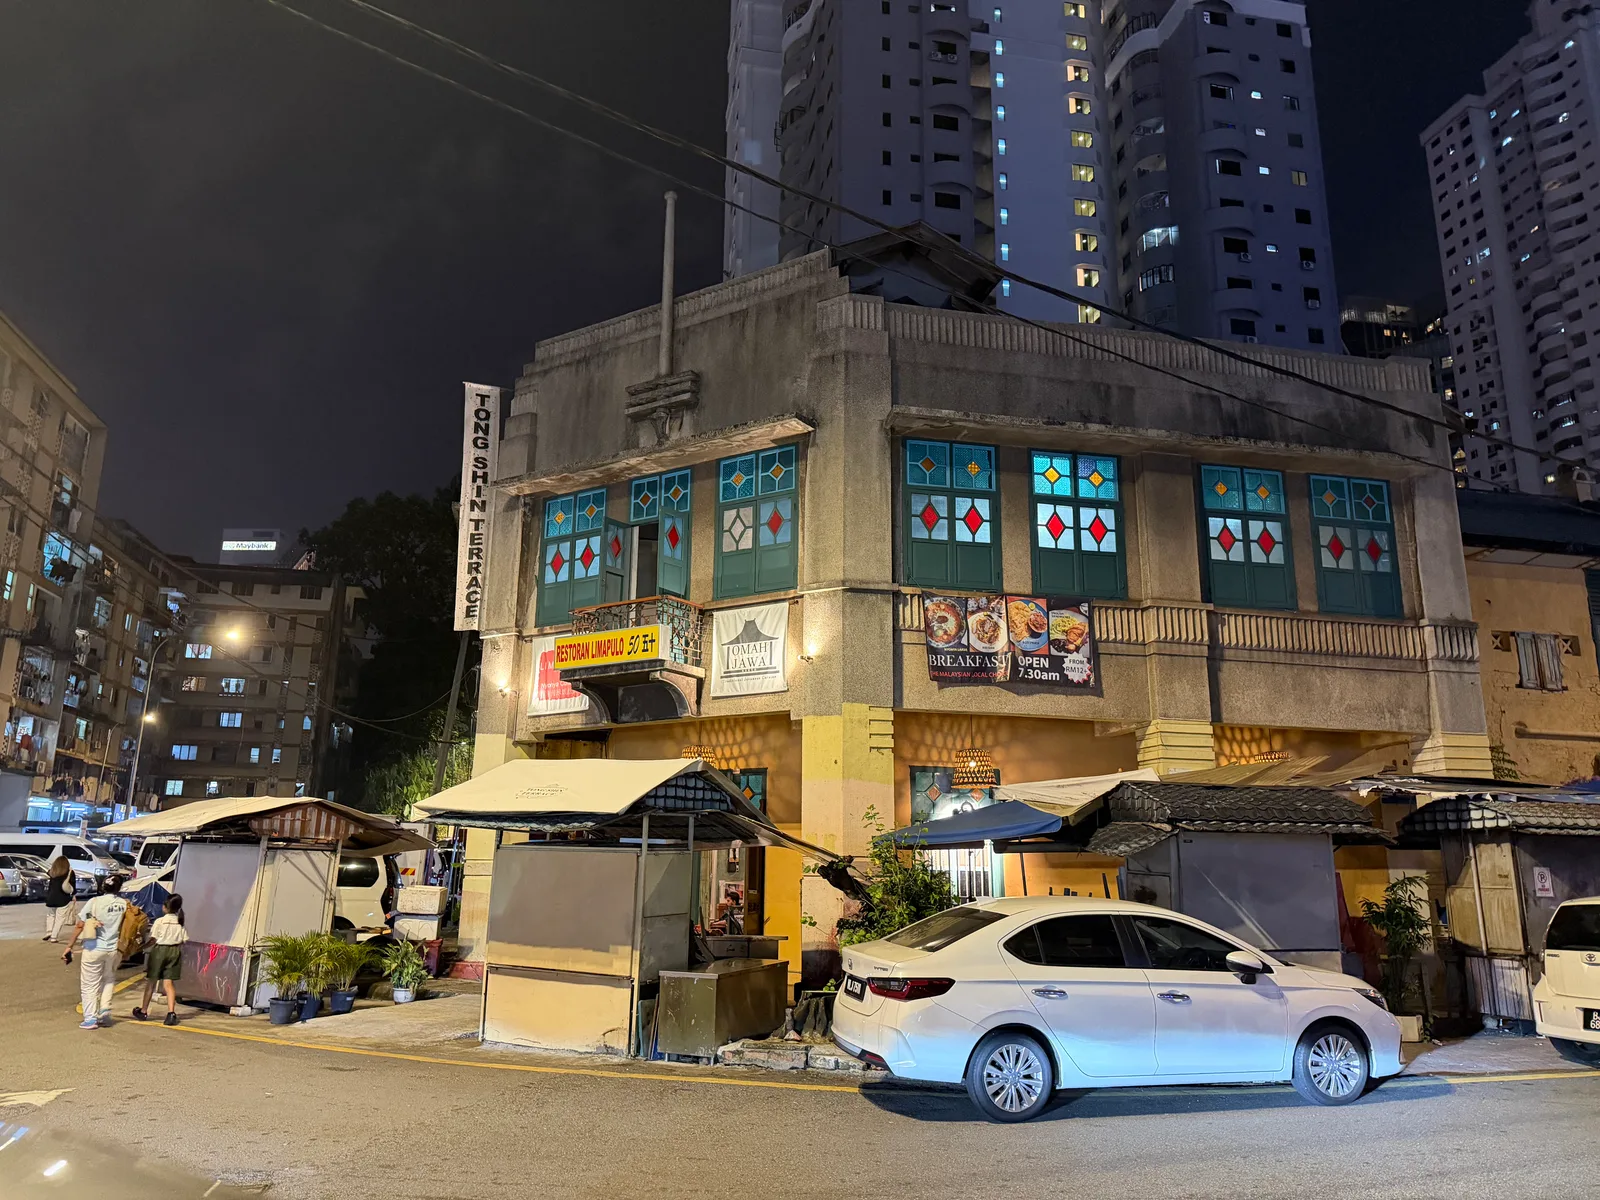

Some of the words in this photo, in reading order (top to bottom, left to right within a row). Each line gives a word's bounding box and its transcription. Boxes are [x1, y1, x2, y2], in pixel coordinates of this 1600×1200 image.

[472, 393, 491, 450] TONG
[469, 456, 489, 512] SHIN
[236, 542, 269, 550] Maybank
[465, 518, 485, 618] TERRACE
[556, 641, 590, 663] RESTORAN
[591, 637, 625, 659] LIMAPULO
[627, 634, 640, 656] 50
[731, 642, 767, 656] OMAH
[731, 656, 766, 669] JAWA
[928, 654, 1009, 668] BREAKFAST
[1018, 655, 1049, 668] OPEN
[1018, 667, 1060, 681] 7.30am
[1065, 666, 1088, 674] RM12+
